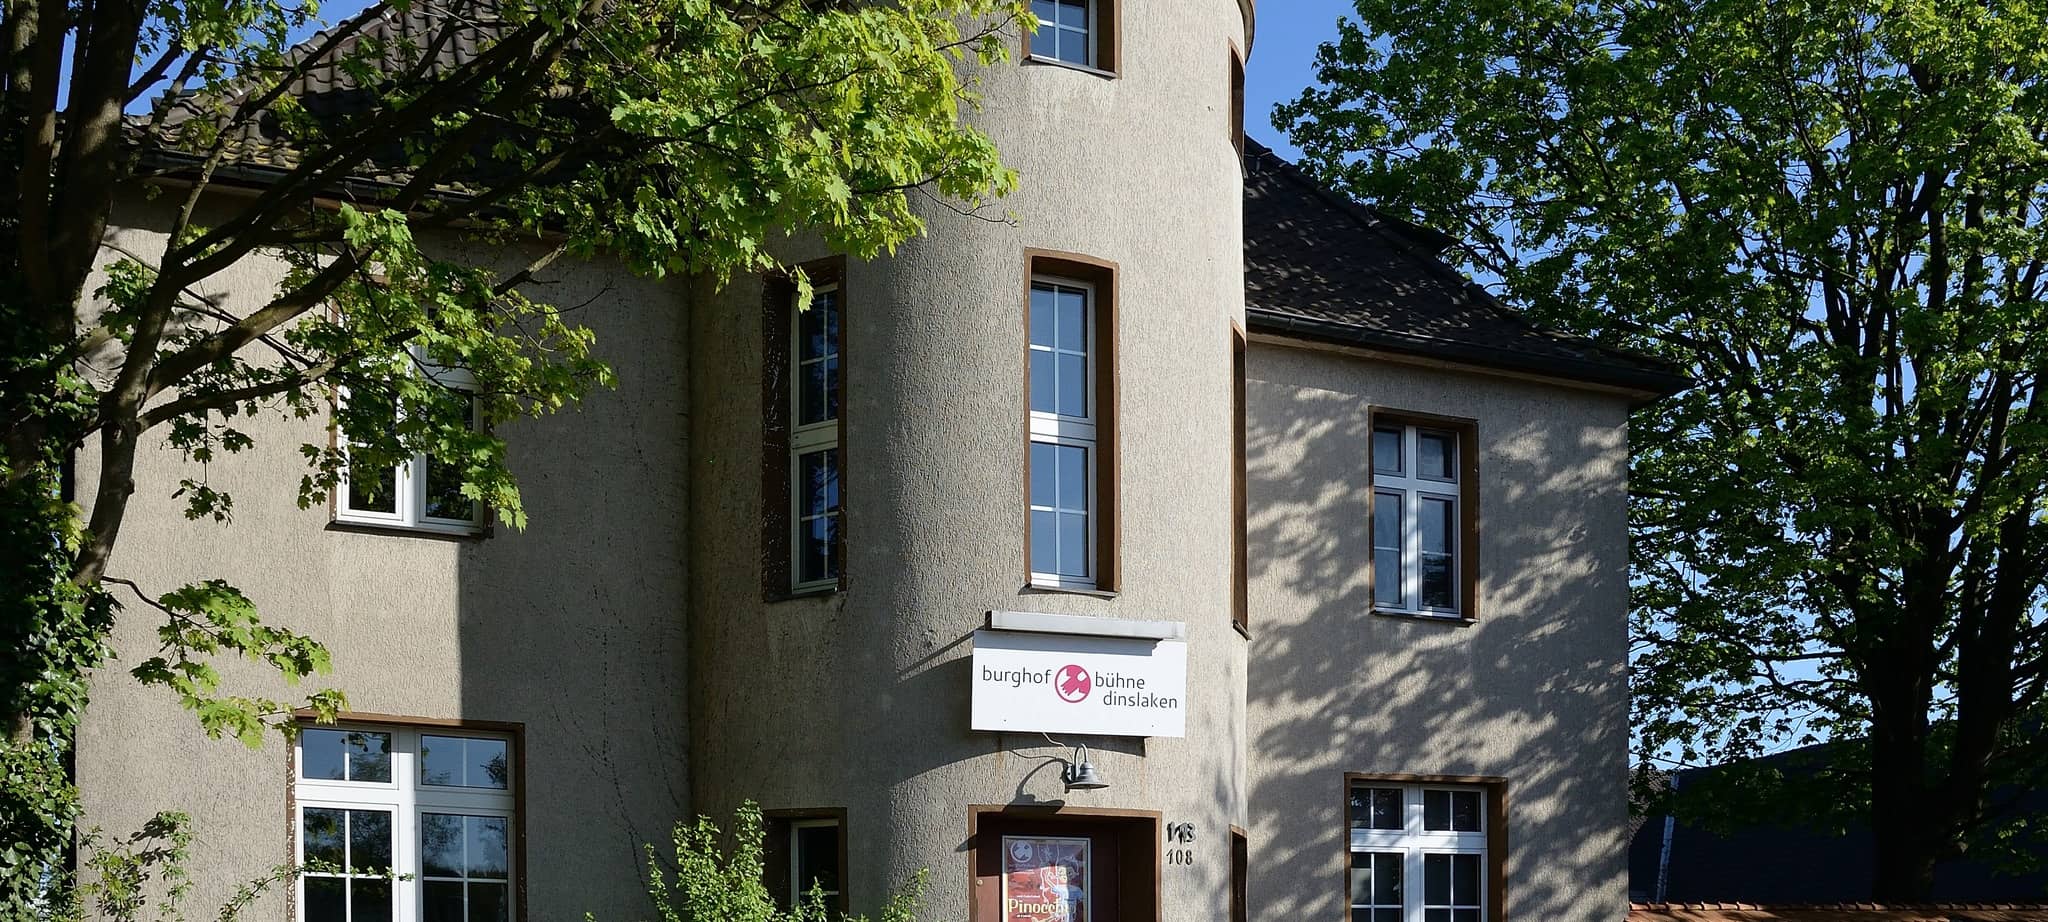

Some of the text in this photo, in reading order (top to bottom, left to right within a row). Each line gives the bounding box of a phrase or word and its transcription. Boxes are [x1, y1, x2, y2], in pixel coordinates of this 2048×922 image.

[982, 664, 1146, 690] burghof bühne
[1103, 690, 1179, 709] dinslaken
[1166, 848, 1193, 866] 108
